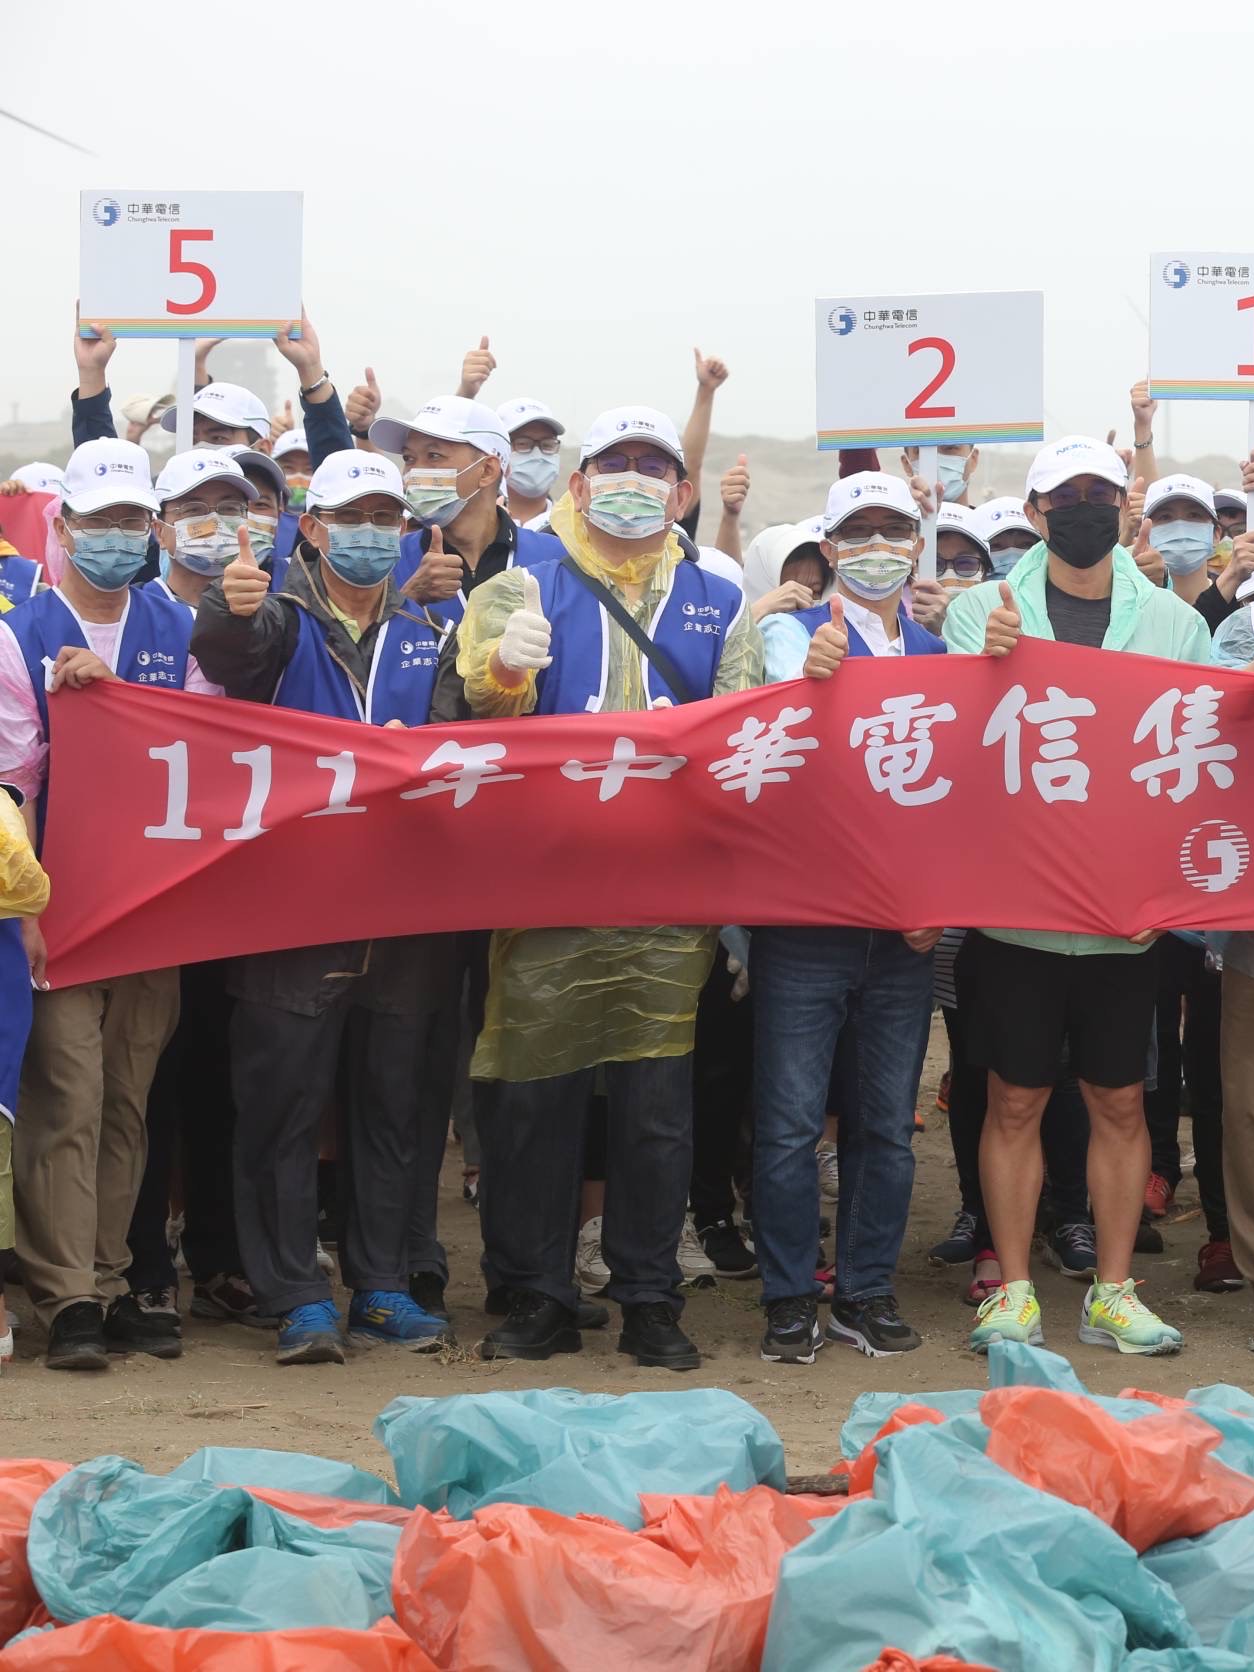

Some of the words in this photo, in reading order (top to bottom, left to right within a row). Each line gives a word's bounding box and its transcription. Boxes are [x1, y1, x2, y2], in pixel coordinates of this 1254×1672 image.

[127, 203, 181, 216] 中華電信
[165, 229, 217, 315] 5
[1196, 265, 1250, 278] 中華電信
[863, 308, 918, 322] 中華電信
[904, 336, 956, 419] 2
